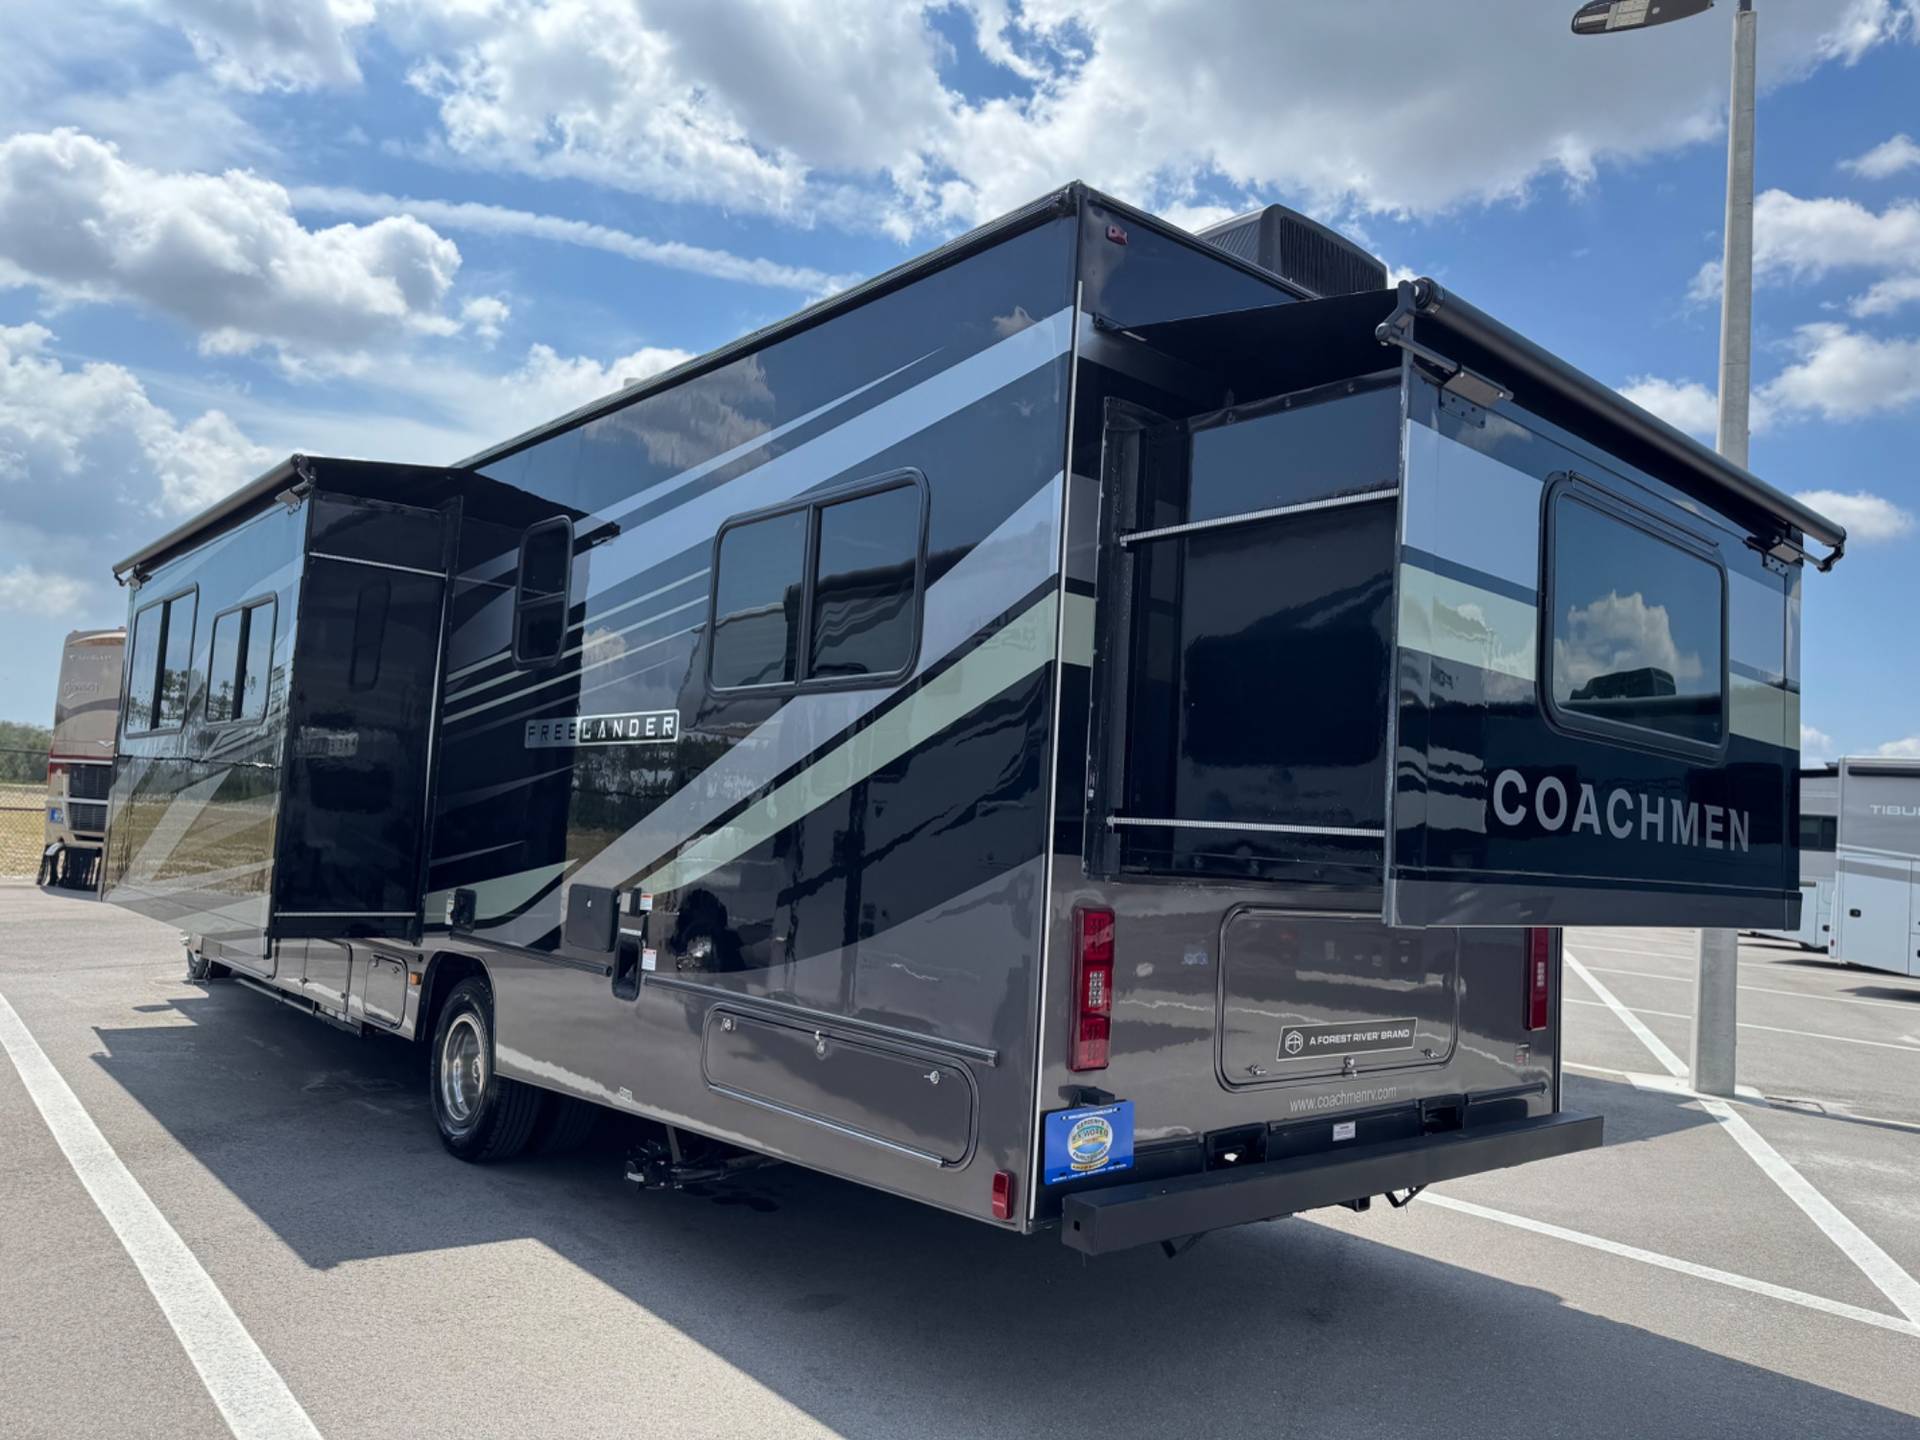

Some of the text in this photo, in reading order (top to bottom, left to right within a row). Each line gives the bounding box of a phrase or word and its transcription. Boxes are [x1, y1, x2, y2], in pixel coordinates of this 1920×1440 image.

[527, 715, 674, 742] FREELANDER
[1492, 768, 1750, 854] COACHMEN
[1869, 804, 1920, 816] TIBU
[1309, 1036, 1316, 1045] A
[1317, 1034, 1352, 1044] FOREST
[1380, 1029, 1410, 1040] BRAND
